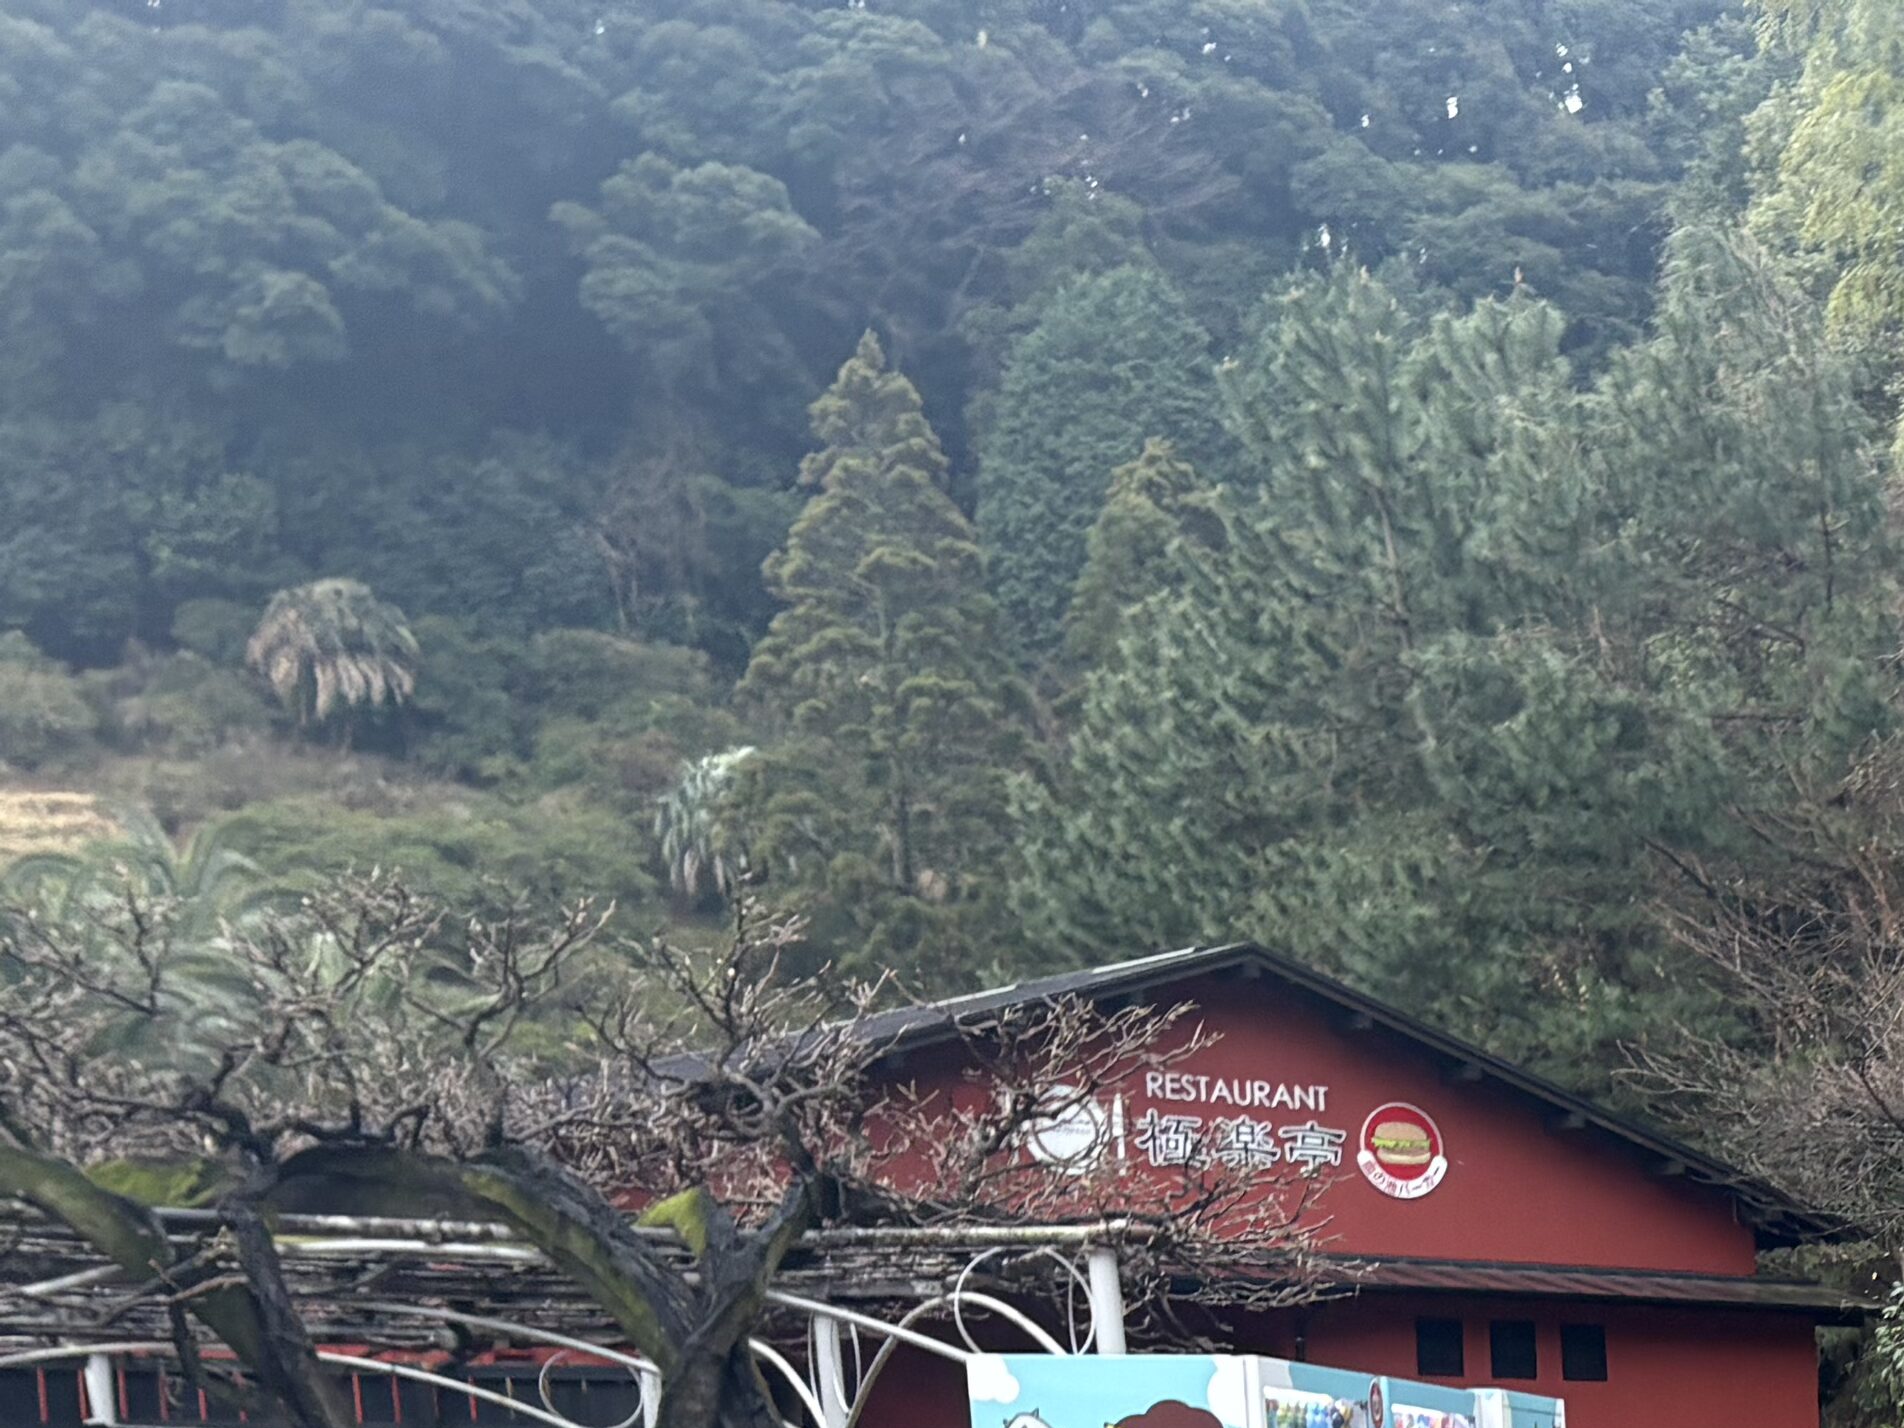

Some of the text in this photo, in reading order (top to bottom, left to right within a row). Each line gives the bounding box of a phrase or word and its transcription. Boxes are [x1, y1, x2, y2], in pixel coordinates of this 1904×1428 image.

[1145, 1071, 1328, 1112] RESTAURANT
[1134, 1107, 1347, 1178] 極楽亭
